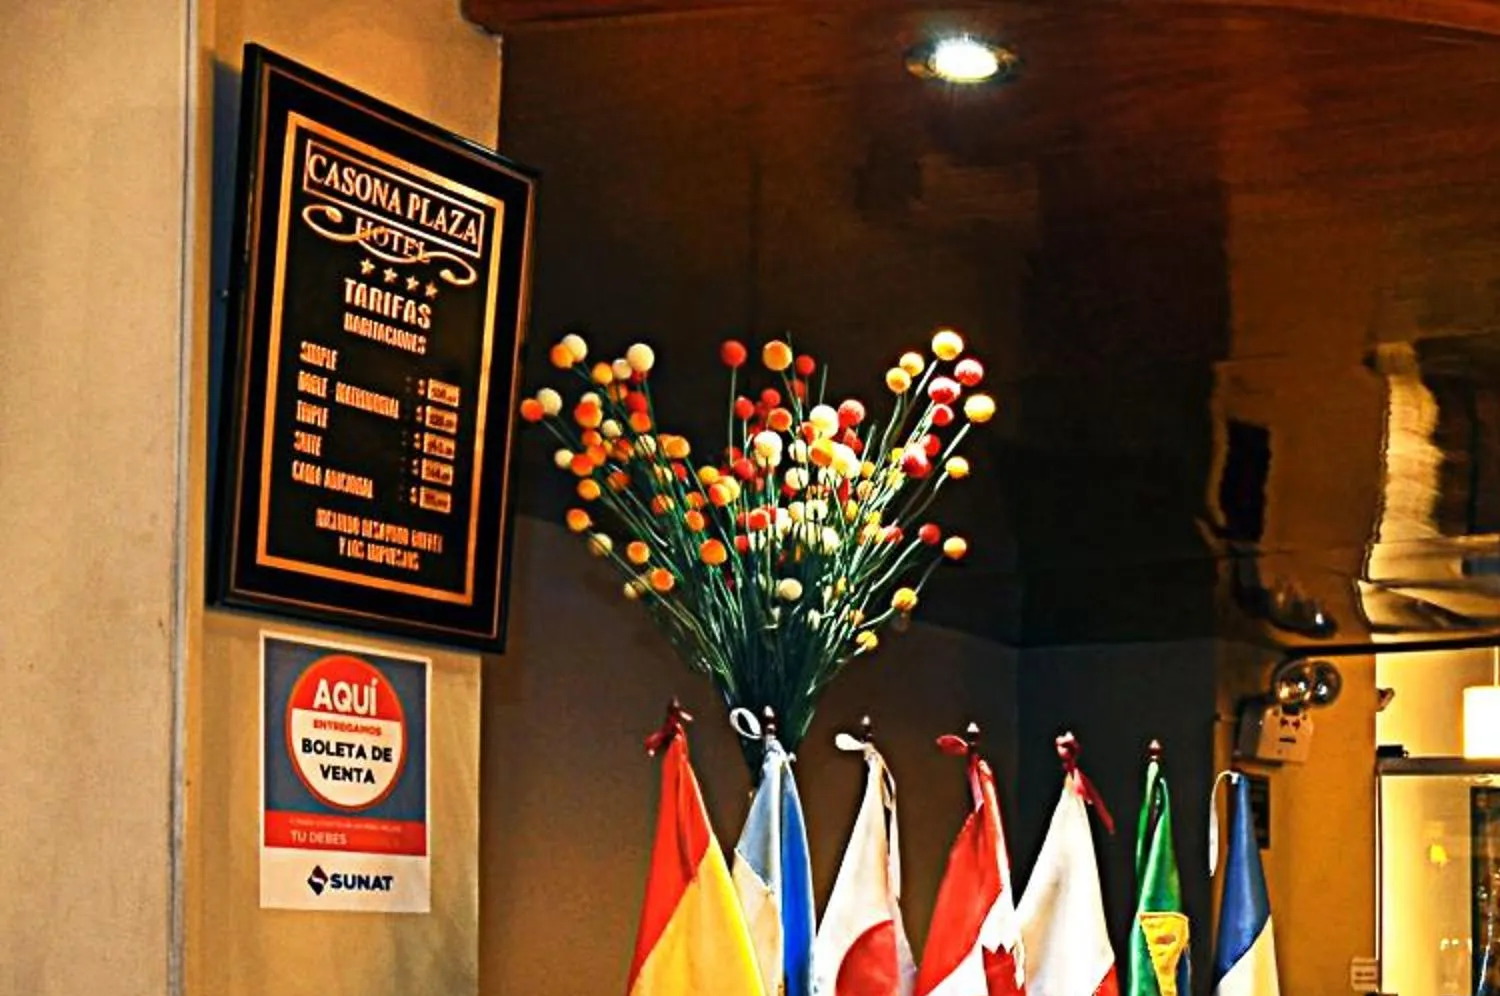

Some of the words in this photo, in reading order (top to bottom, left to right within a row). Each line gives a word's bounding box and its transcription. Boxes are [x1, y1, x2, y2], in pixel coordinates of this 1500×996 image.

[308, 154, 401, 216] CASONA
[407, 193, 478, 245] PLAZA
[355, 217, 430, 263] HOTEL
[344, 278, 432, 329] TARIFAS
[312, 678, 378, 716] AQUÍ
[301, 737, 367, 761] BOLETA
[371, 746, 393, 763] DE
[319, 764, 375, 785] VENTA
[330, 873, 394, 892] SUNAT
